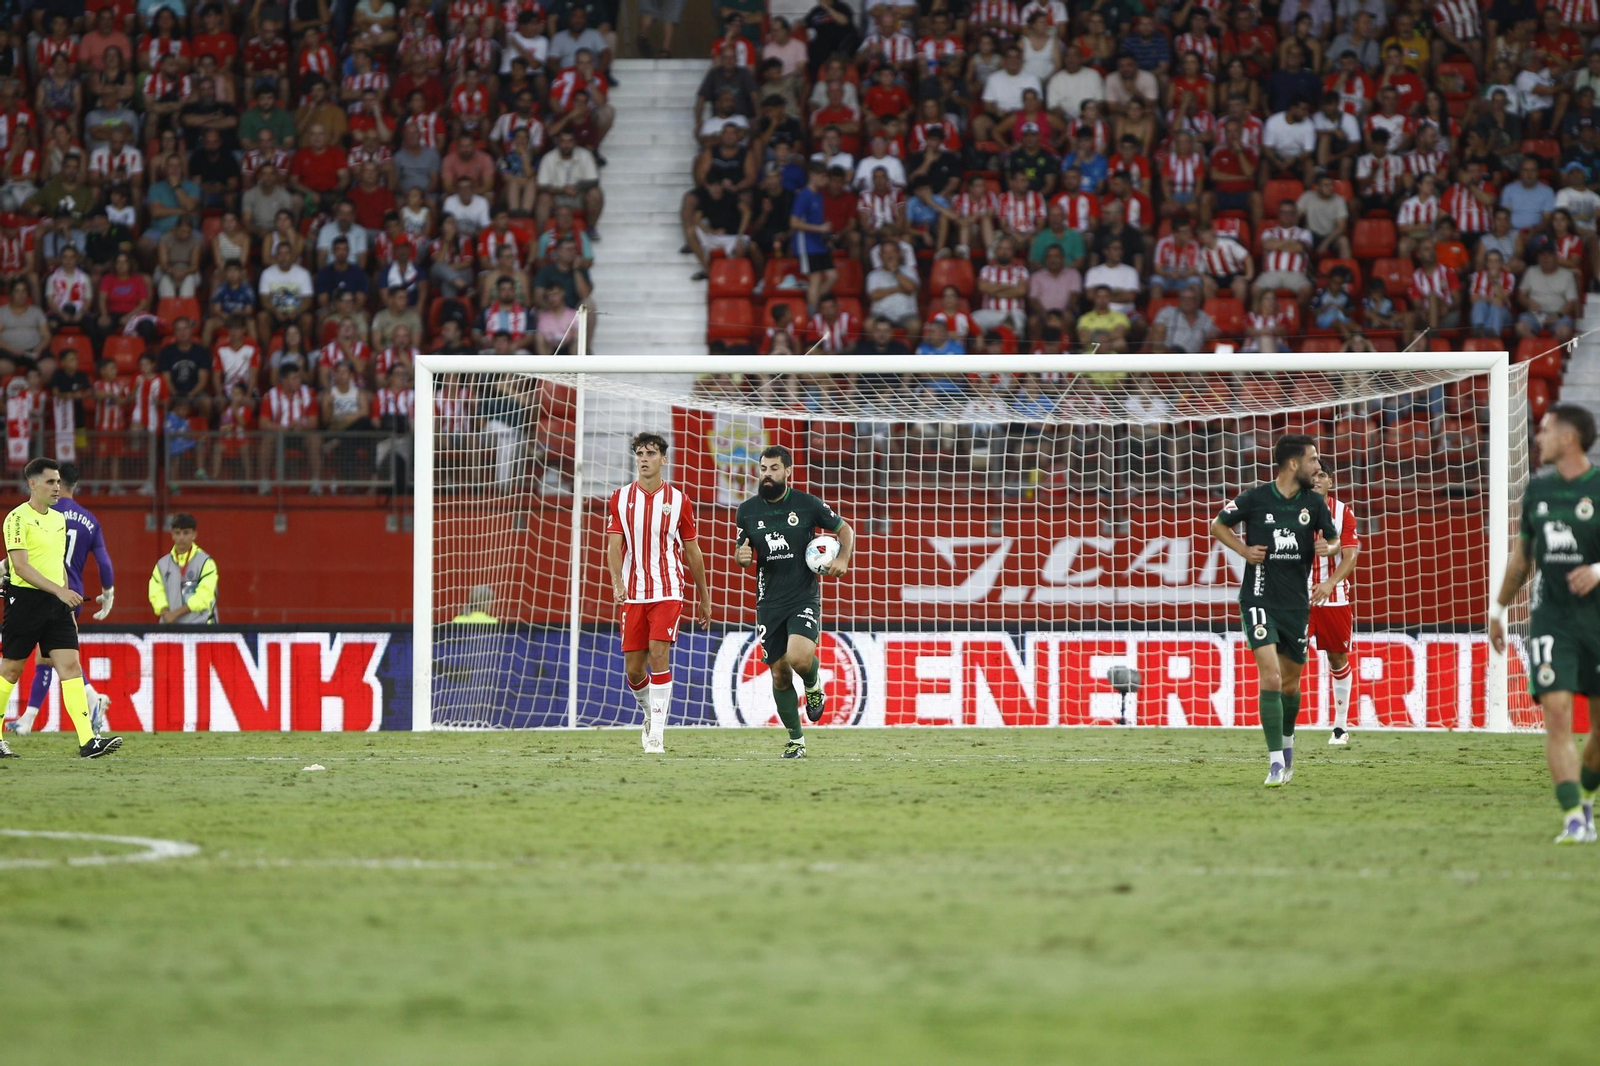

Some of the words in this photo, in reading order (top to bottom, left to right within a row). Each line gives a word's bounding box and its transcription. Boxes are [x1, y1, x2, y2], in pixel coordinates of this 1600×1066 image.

[766, 553, 794, 562] plenitude
[1248, 606, 1267, 626] 11
[758, 624, 767, 643] 2
[1531, 634, 1555, 666] 17
